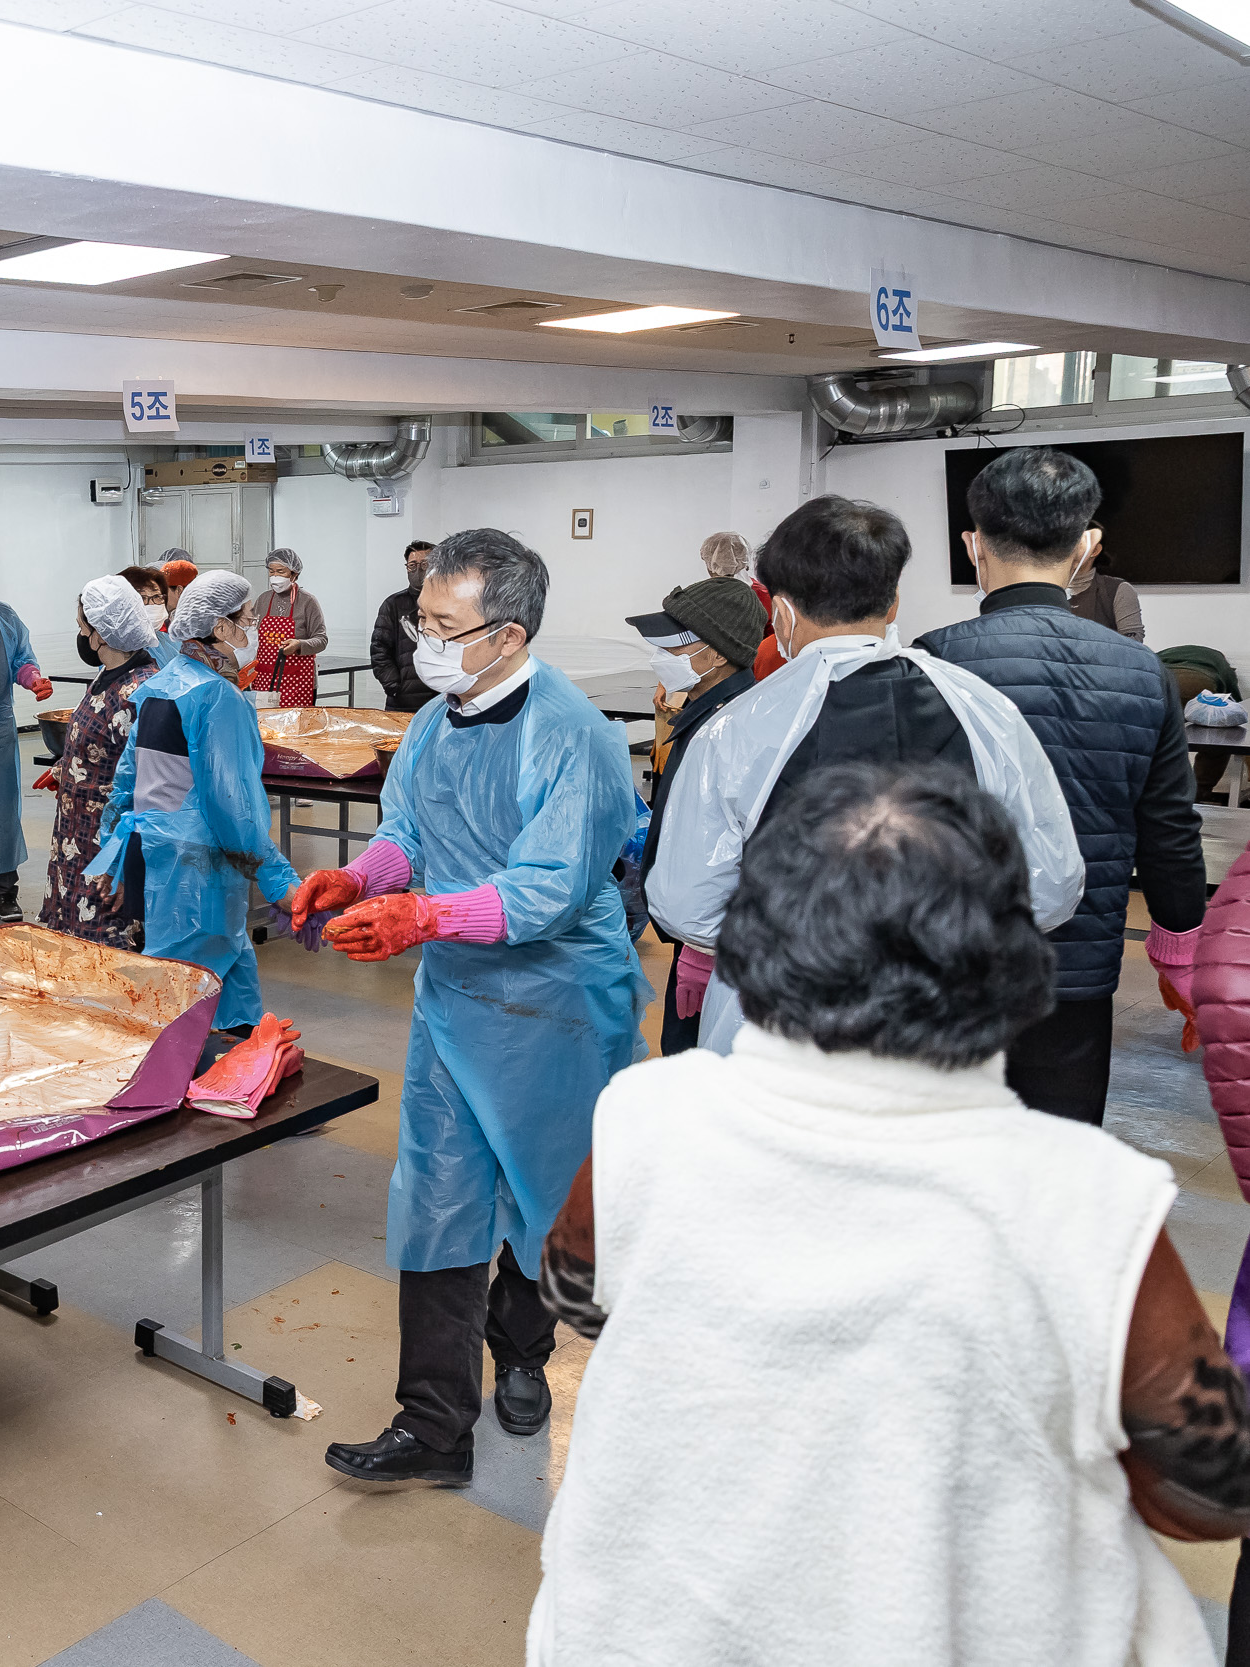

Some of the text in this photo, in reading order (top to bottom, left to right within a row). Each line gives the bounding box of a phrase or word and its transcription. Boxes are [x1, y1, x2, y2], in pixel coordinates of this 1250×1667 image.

[877, 286, 913, 332] 6조
[131, 391, 171, 421] 5조
[653, 405, 675, 428] 2조
[249, 438, 271, 456] 1조
